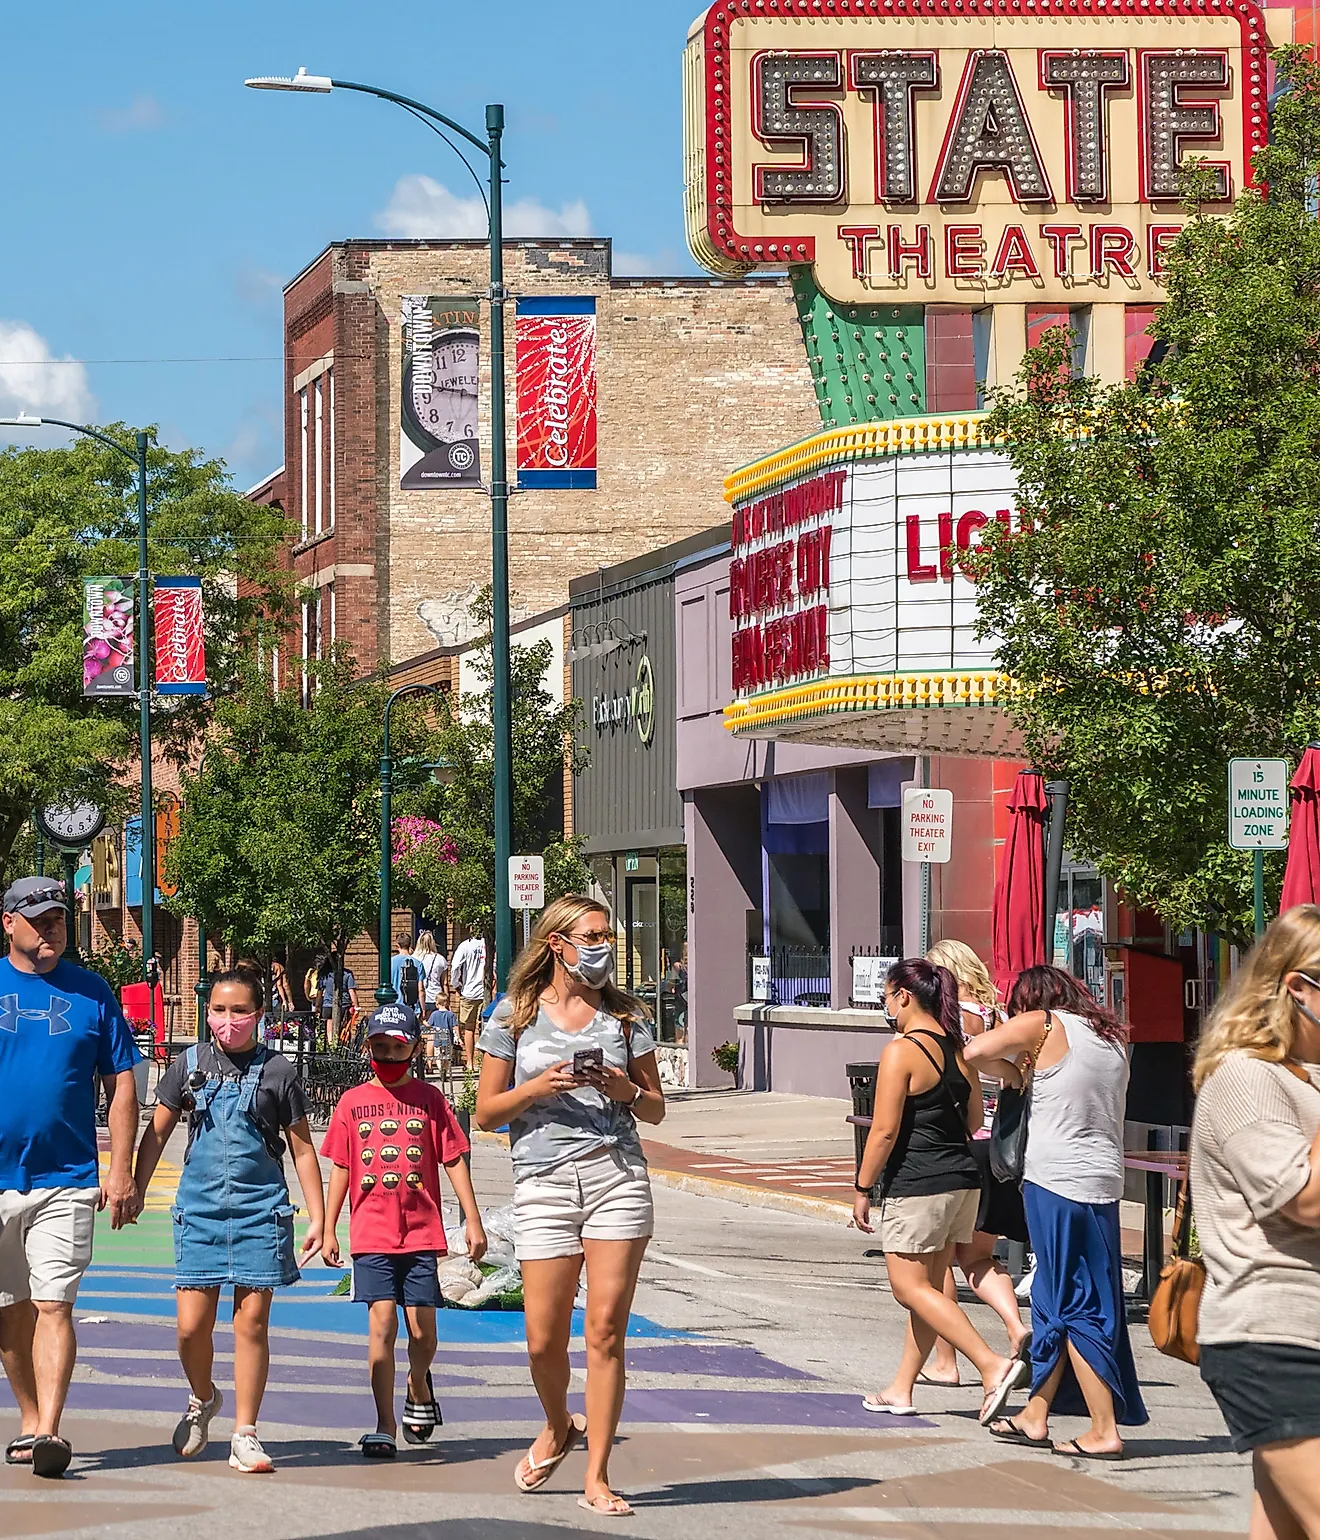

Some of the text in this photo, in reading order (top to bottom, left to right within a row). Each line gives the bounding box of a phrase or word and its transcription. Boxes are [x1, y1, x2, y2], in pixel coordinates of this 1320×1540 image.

[752, 48, 1232, 204] STATE
[838, 224, 1185, 280] THEATRE
[412, 309, 432, 393] DOWNTOWN
[451, 349, 466, 363] 12
[436, 356, 448, 370] 11
[543, 319, 569, 467] Celebrate!
[429, 408, 439, 423] 8
[446, 421, 454, 432] 7
[464, 424, 473, 438] 6
[454, 452, 467, 462] TC
[90, 584, 104, 637] DOWNTOWN
[171, 590, 187, 682] Celebrate!
[1252, 771, 1265, 783] 15
[1237, 789, 1280, 801] MINUTE
[922, 799, 934, 809] NO
[86, 814, 92, 823] 4
[910, 813, 945, 824] PARKING
[1233, 806, 1284, 819] LOADING
[67, 824, 73, 834] 6
[78, 821, 85, 831] 5
[1243, 824, 1275, 836] ZONE
[909, 827, 945, 838] THEATER
[917, 841, 936, 852] EXIT
[521, 863, 531, 871] NO
[513, 873, 539, 881] PARKING
[513, 883, 540, 891] THEATER
[351, 1103, 384, 1121] MOODS
[397, 1102, 430, 1116] NINJA
